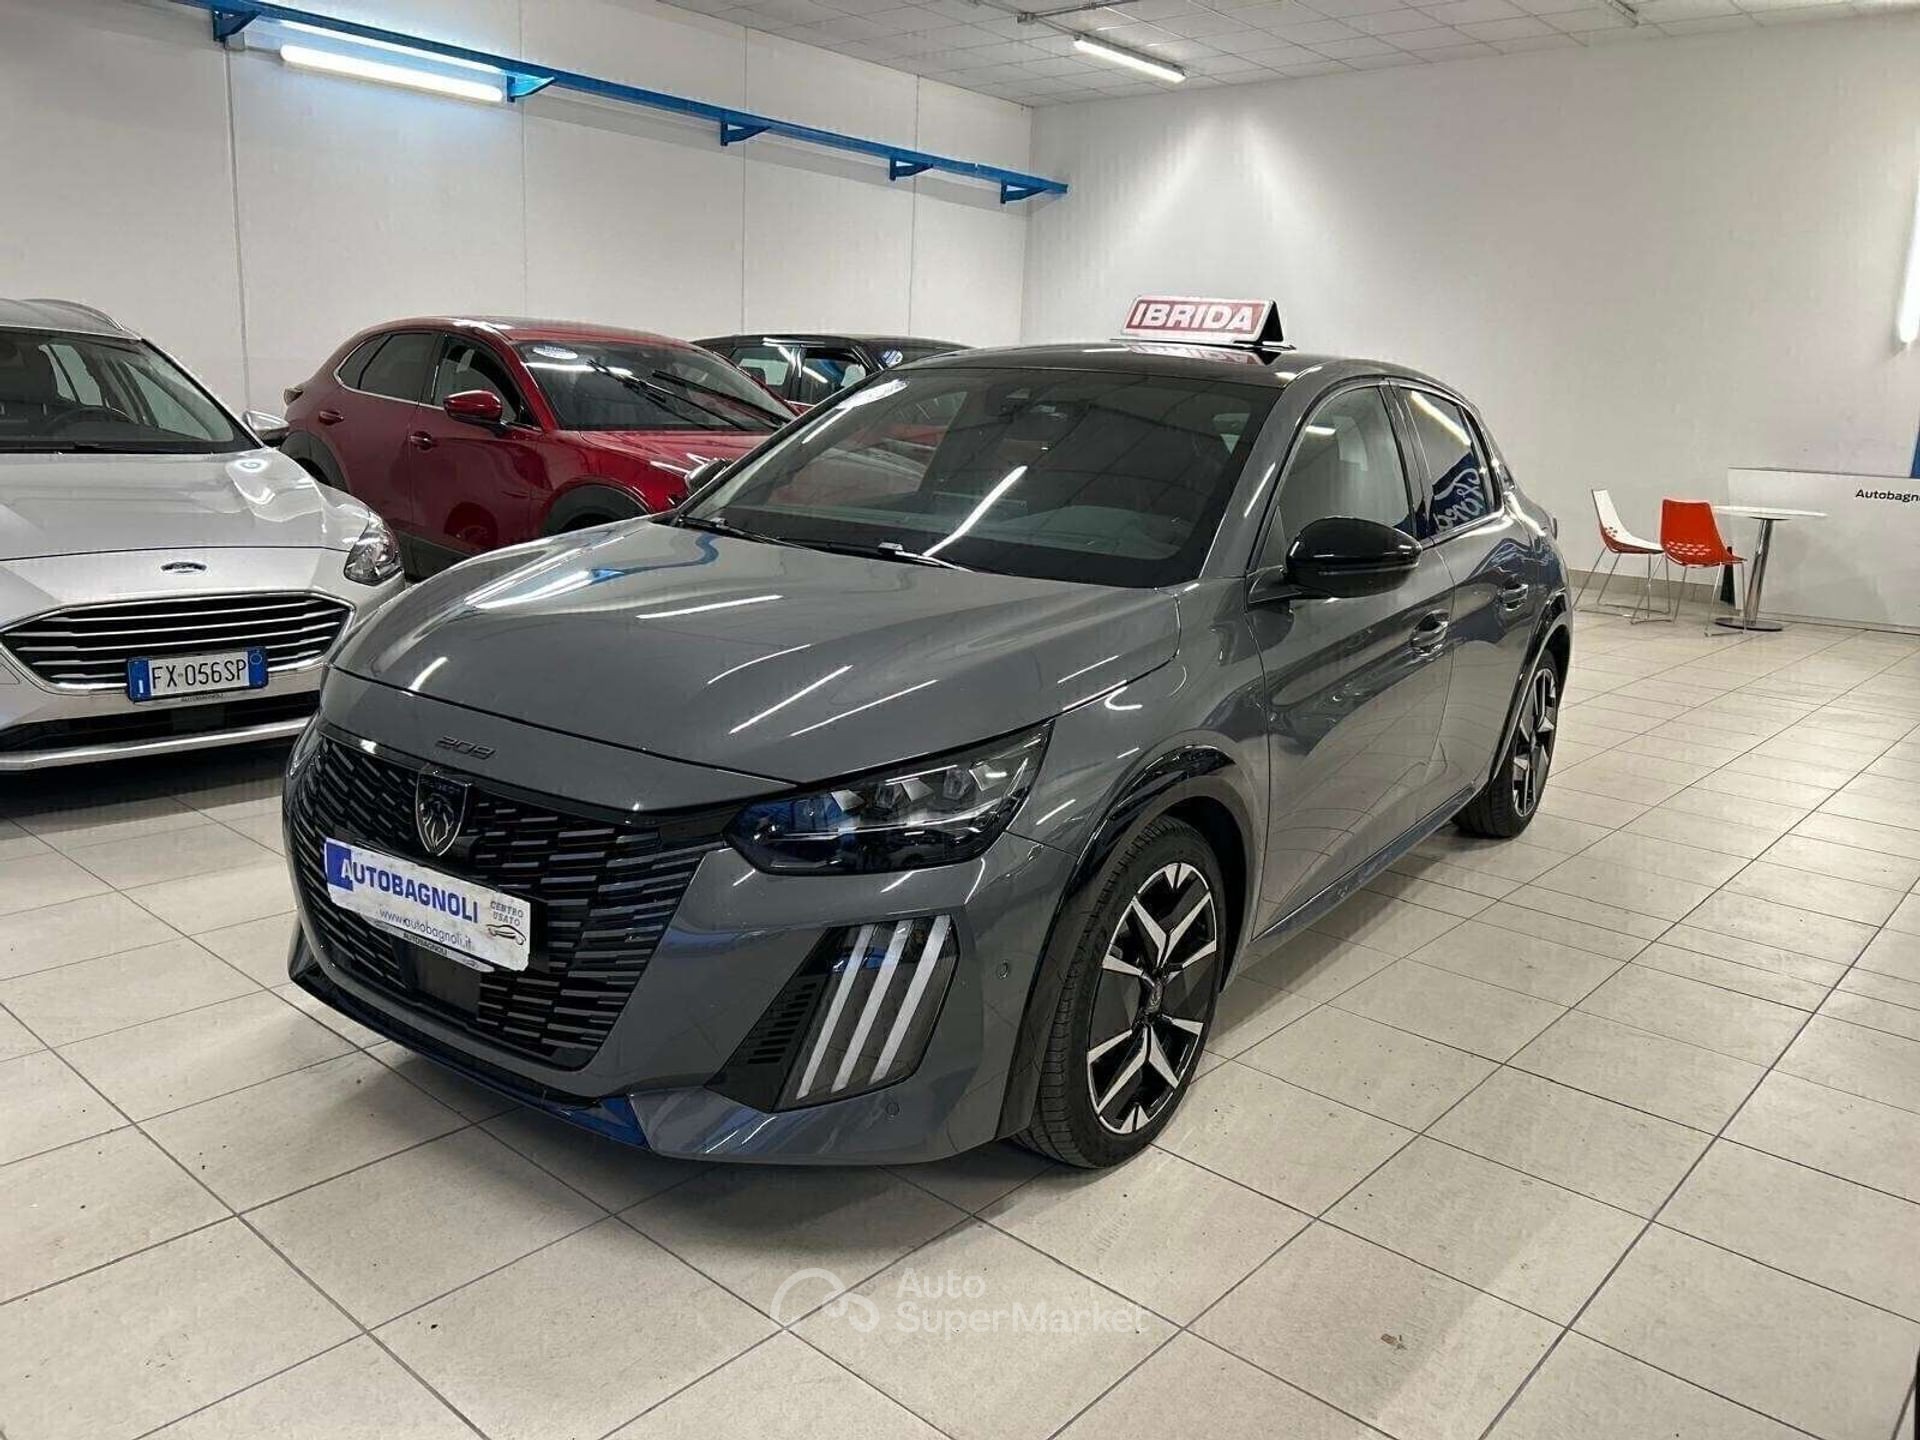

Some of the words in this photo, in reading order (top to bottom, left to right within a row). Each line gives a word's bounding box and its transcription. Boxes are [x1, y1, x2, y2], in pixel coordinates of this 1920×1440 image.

[1131, 303, 1253, 330] IBRIDA
[1855, 489, 1920, 503] Autobagn
[435, 736, 496, 760] 208
[341, 858, 478, 924] AUTOBAGNOLI
[490, 901, 525, 918] CENTRO
[493, 912, 521, 927] USATO
[379, 908, 473, 951] www.autobagnoli.it
